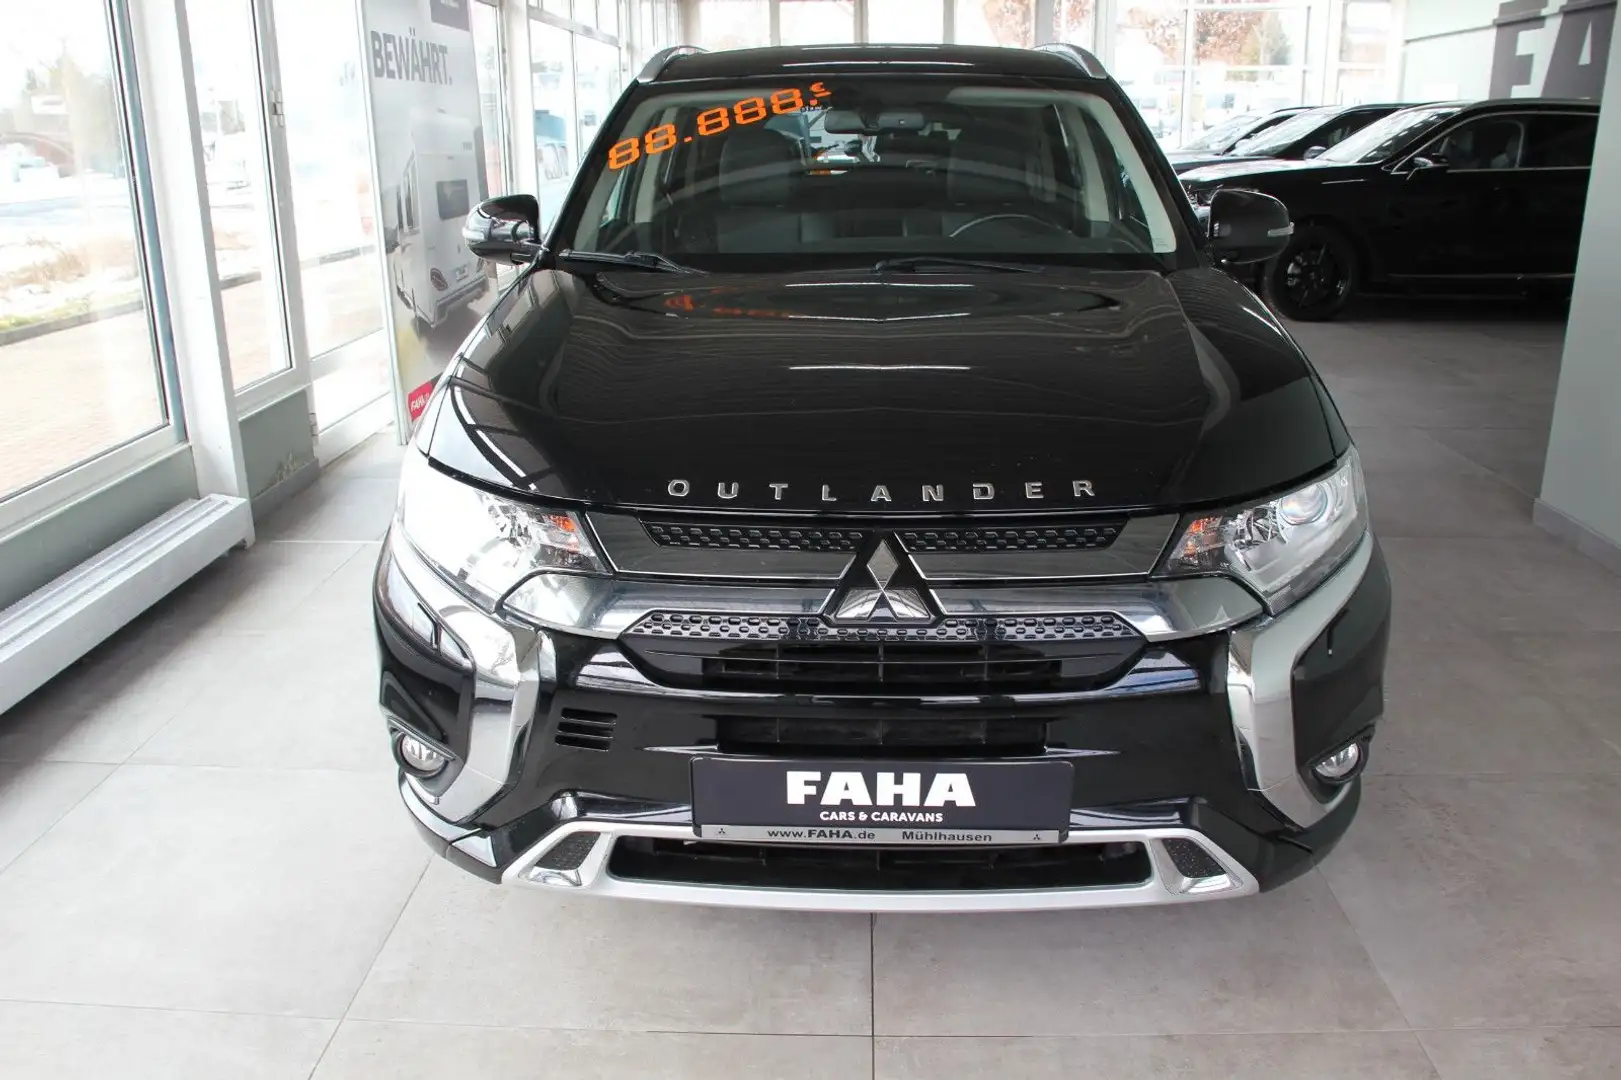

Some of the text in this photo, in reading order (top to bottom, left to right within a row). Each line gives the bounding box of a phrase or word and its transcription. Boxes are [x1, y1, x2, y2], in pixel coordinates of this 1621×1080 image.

[370, 27, 453, 85] BEWÄHRT.
[667, 479, 1095, 502] OUTLANDER
[786, 770, 976, 807] FAHA
[819, 810, 944, 823] CARS & CARAVANS
[766, 829, 993, 843] www.FAHA.de Mühlhausen
